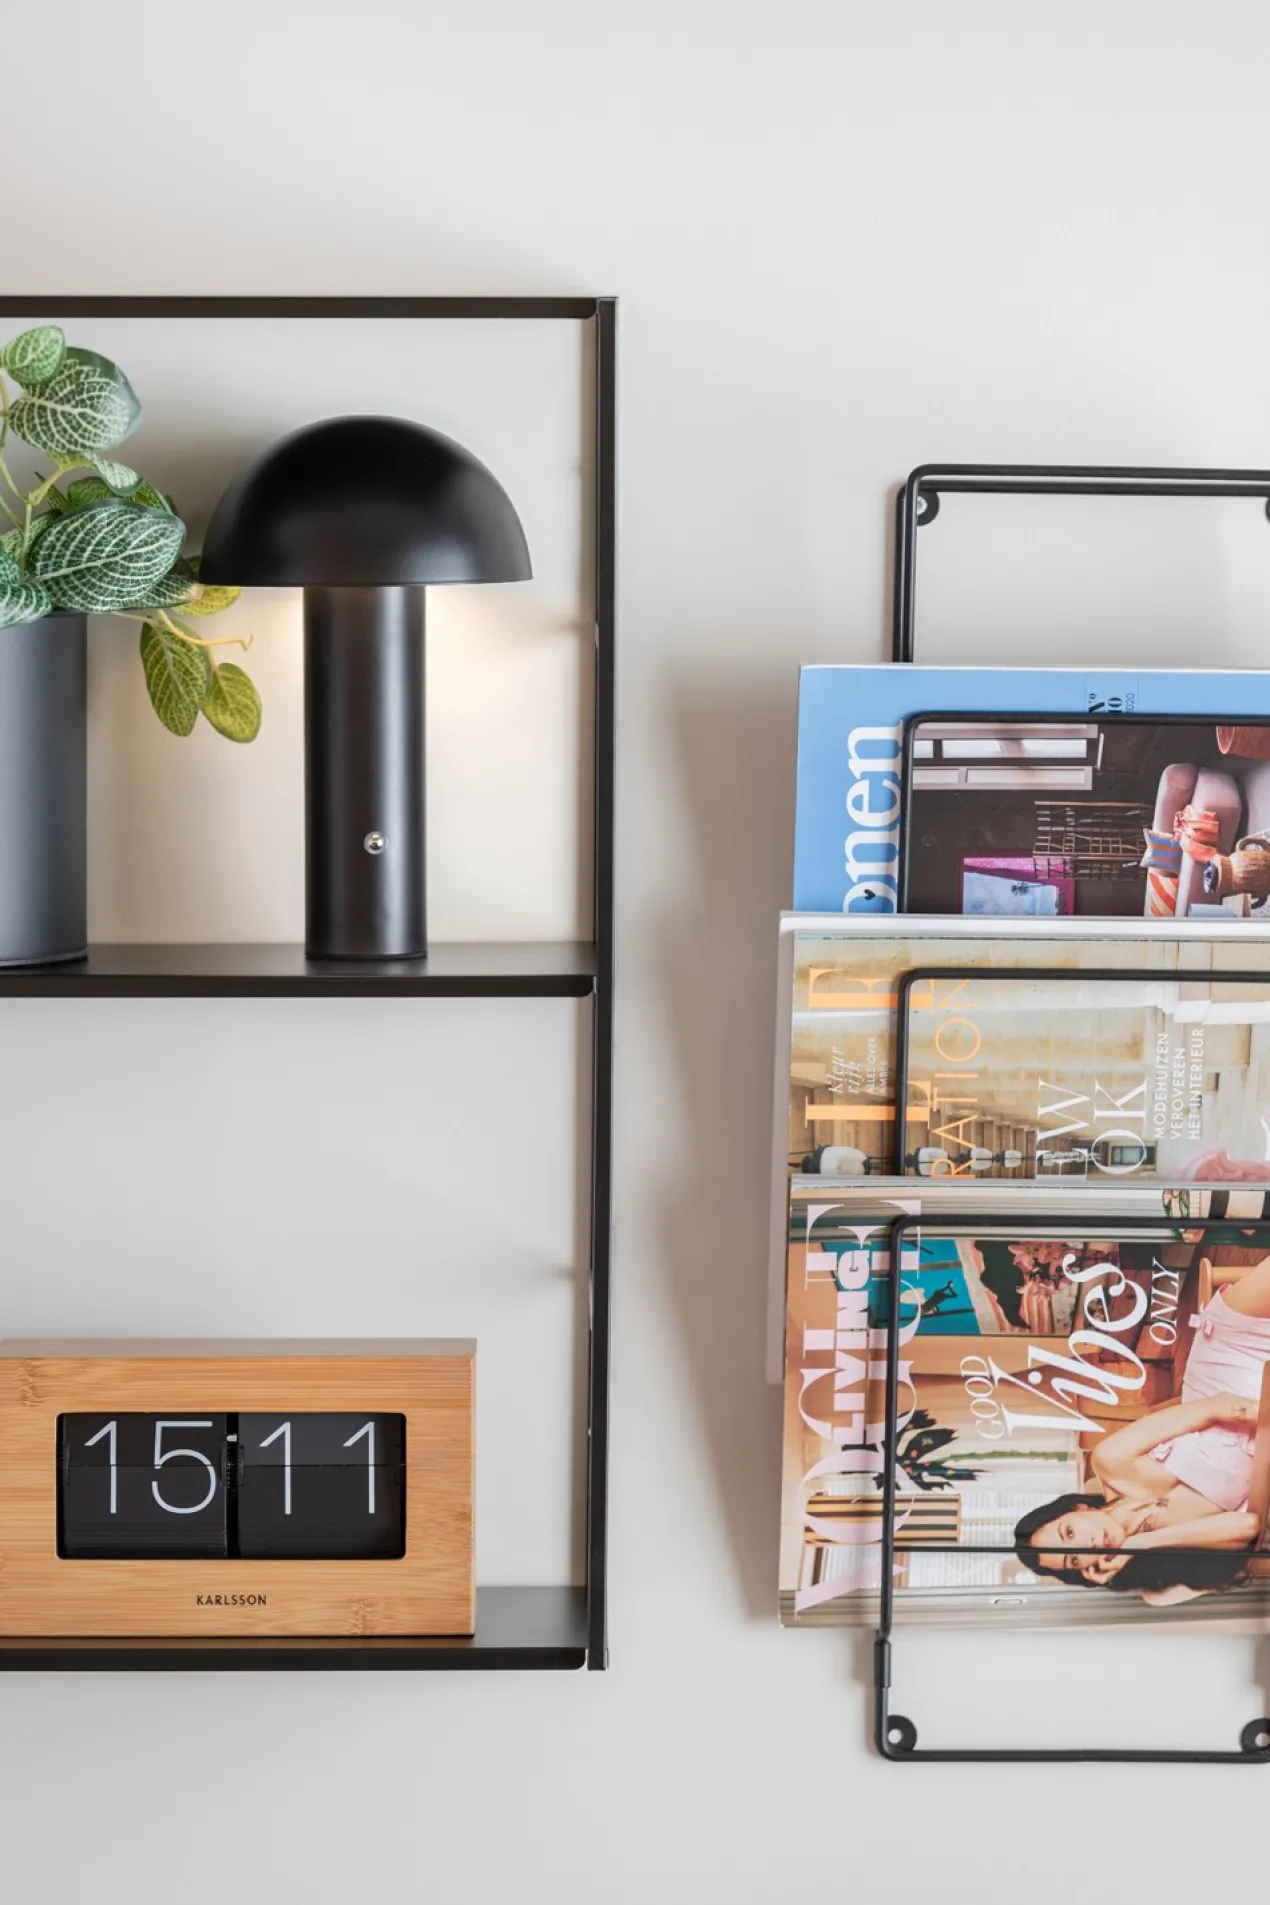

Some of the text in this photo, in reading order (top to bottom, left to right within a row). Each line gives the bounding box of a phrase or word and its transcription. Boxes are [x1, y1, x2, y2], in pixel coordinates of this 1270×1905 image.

[867, 1037, 877, 1063] OVER
[1154, 1032, 1170, 1140] MODEHUIZEN
[1170, 1047, 1186, 1140] VEROVEREN
[1186, 1028, 1204, 1140] HET INTERIEUR
[1090, 1078, 1148, 1174] OK
[832, 1250, 871, 1445] LIVING
[987, 1252, 1148, 1437] Vibes
[1149, 1257, 1181, 1346] ONLY
[959, 1355, 1005, 1440] GOOD
[84, 1420, 375, 1515] 15 11
[195, 1594, 267, 1606] KARLSSON
